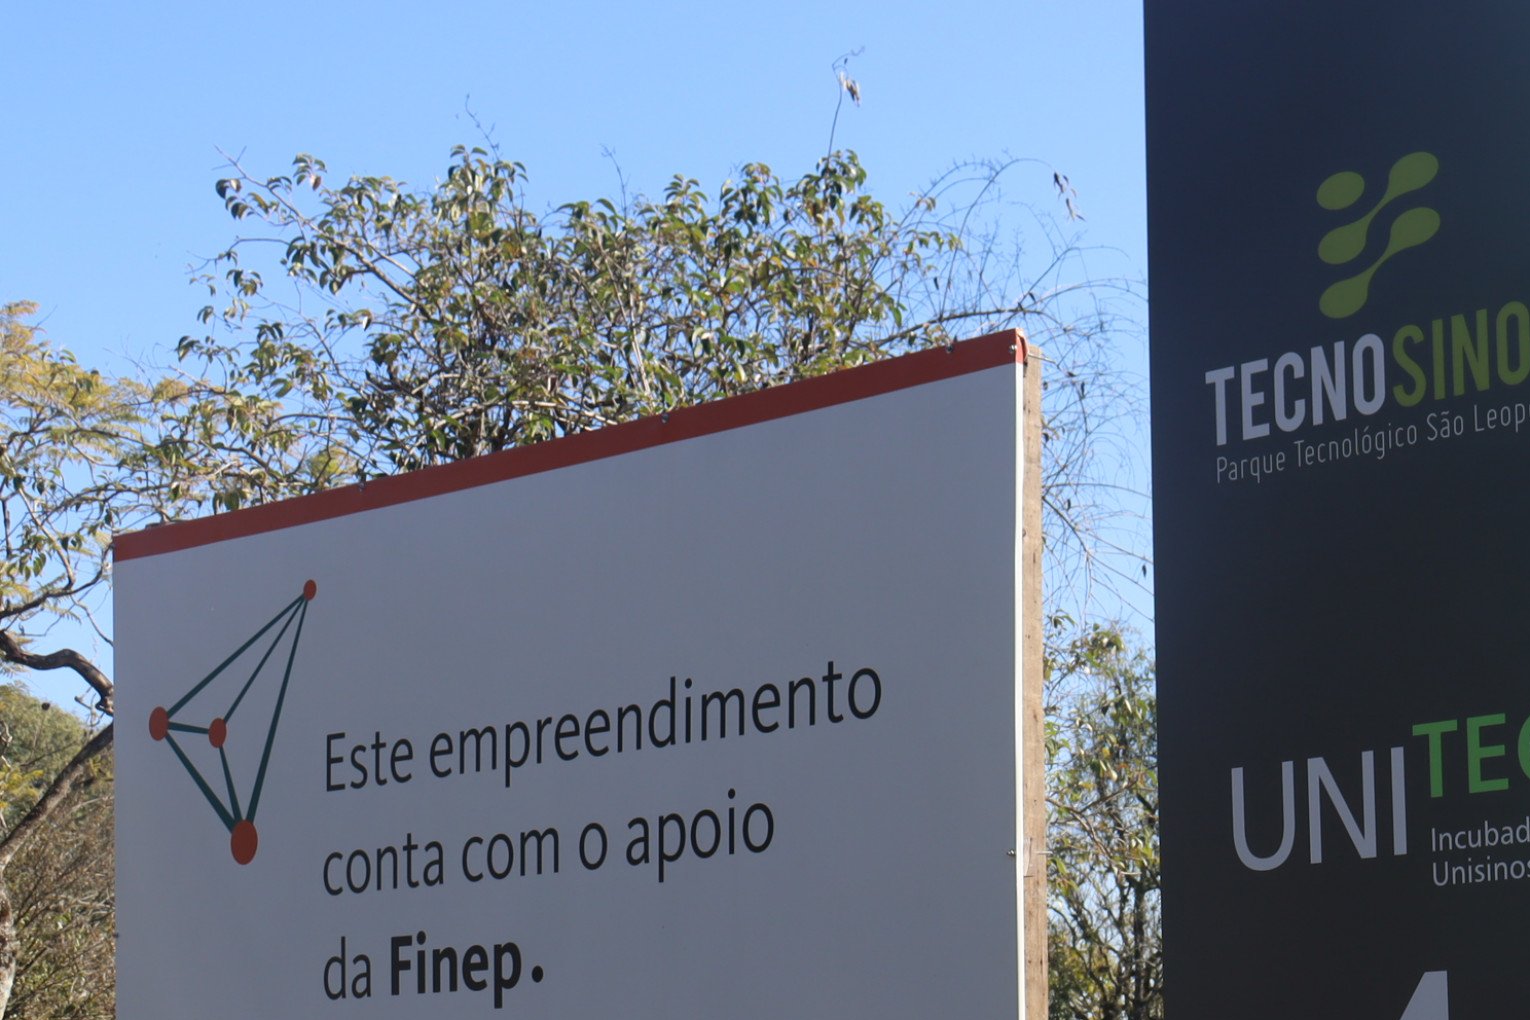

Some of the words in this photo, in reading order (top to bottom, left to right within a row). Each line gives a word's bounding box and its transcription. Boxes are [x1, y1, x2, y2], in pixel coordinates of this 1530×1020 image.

[1216, 447, 1286, 484] Parque
[1294, 423, 1418, 467] Tecnológico
[1426, 410, 1464, 441] São
[326, 728, 415, 792] Este
[429, 660, 883, 788] empreendimento
[323, 830, 446, 896] conta
[461, 827, 562, 884] com
[578, 821, 609, 871] o
[625, 789, 776, 883] apoio
[323, 936, 372, 1000] da
[388, 930, 545, 1009] Finep.
